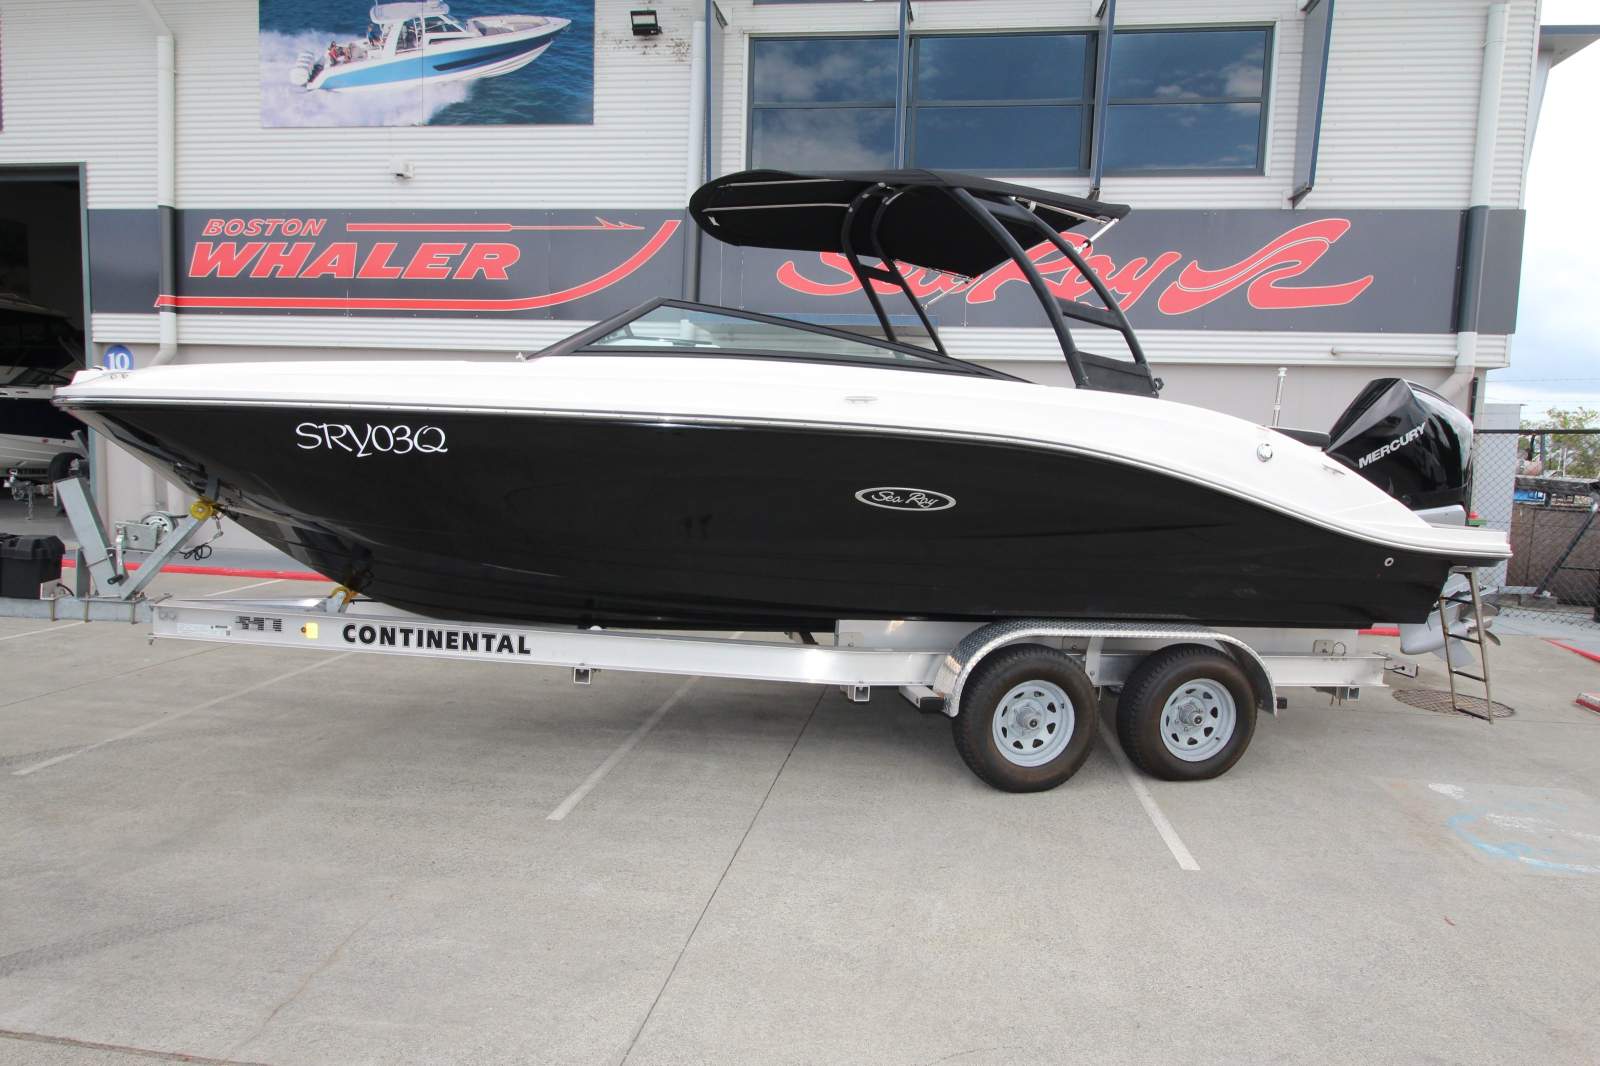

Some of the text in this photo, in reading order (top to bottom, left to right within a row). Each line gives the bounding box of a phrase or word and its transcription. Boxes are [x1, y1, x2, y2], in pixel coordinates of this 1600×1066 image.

[202, 218, 327, 237] BOSTON
[188, 242, 521, 281] WHALER
[107, 352, 130, 370] 10
[295, 422, 449, 458] SRY03Q
[1358, 421, 1426, 469] MERCURY
[871, 491, 939, 509] Sea Ray
[342, 623, 532, 655] CONTINENTAL
